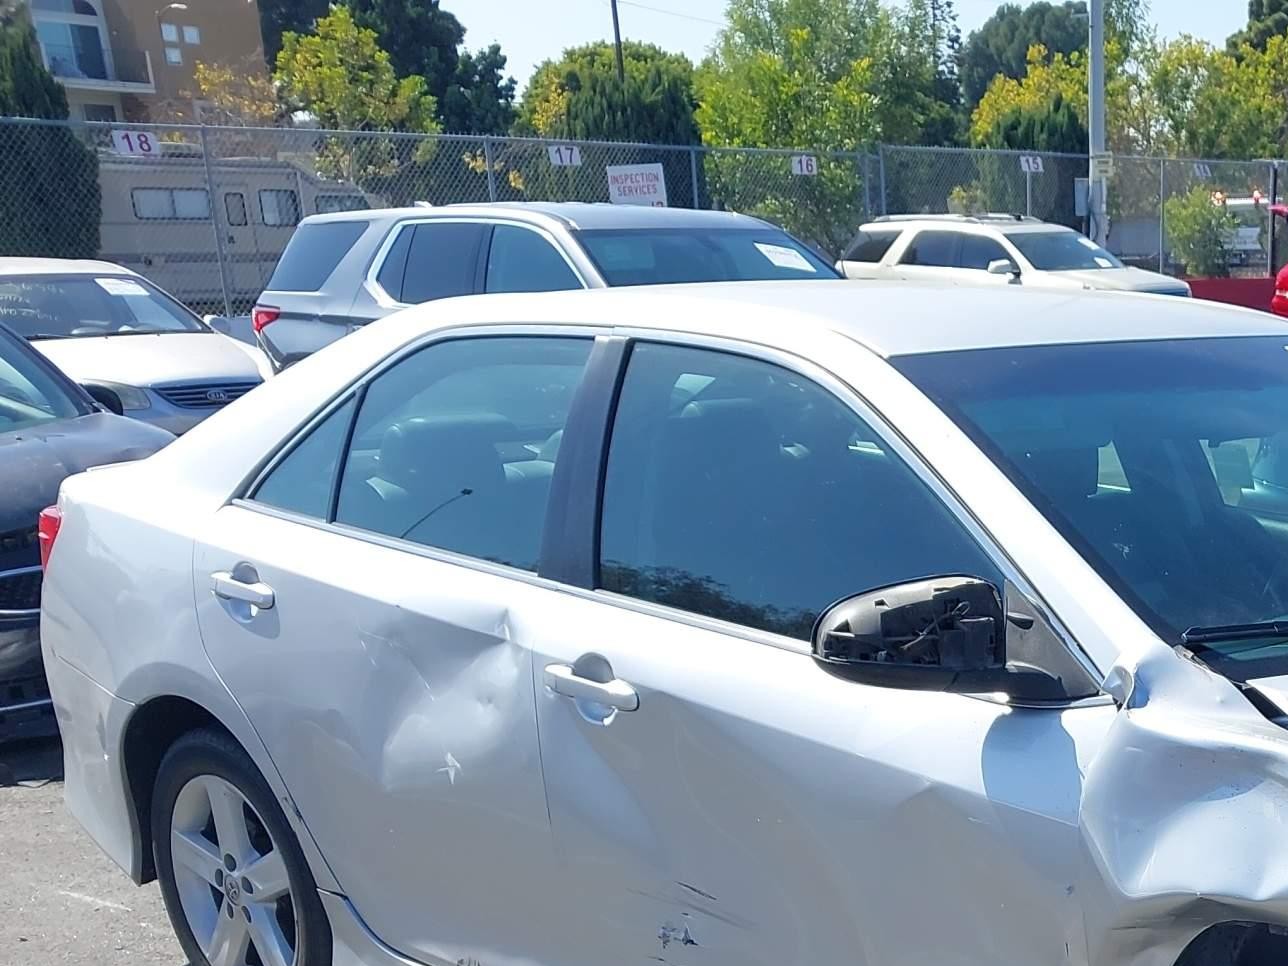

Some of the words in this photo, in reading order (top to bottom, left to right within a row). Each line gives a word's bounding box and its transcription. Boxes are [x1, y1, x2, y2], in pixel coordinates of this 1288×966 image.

[121, 132, 152, 153] 18
[555, 146, 574, 164] 17
[797, 158, 814, 173] 16
[1025, 157, 1040, 170] 15
[610, 172, 660, 185] INSPECTION
[617, 184, 657, 197] SERVICES
